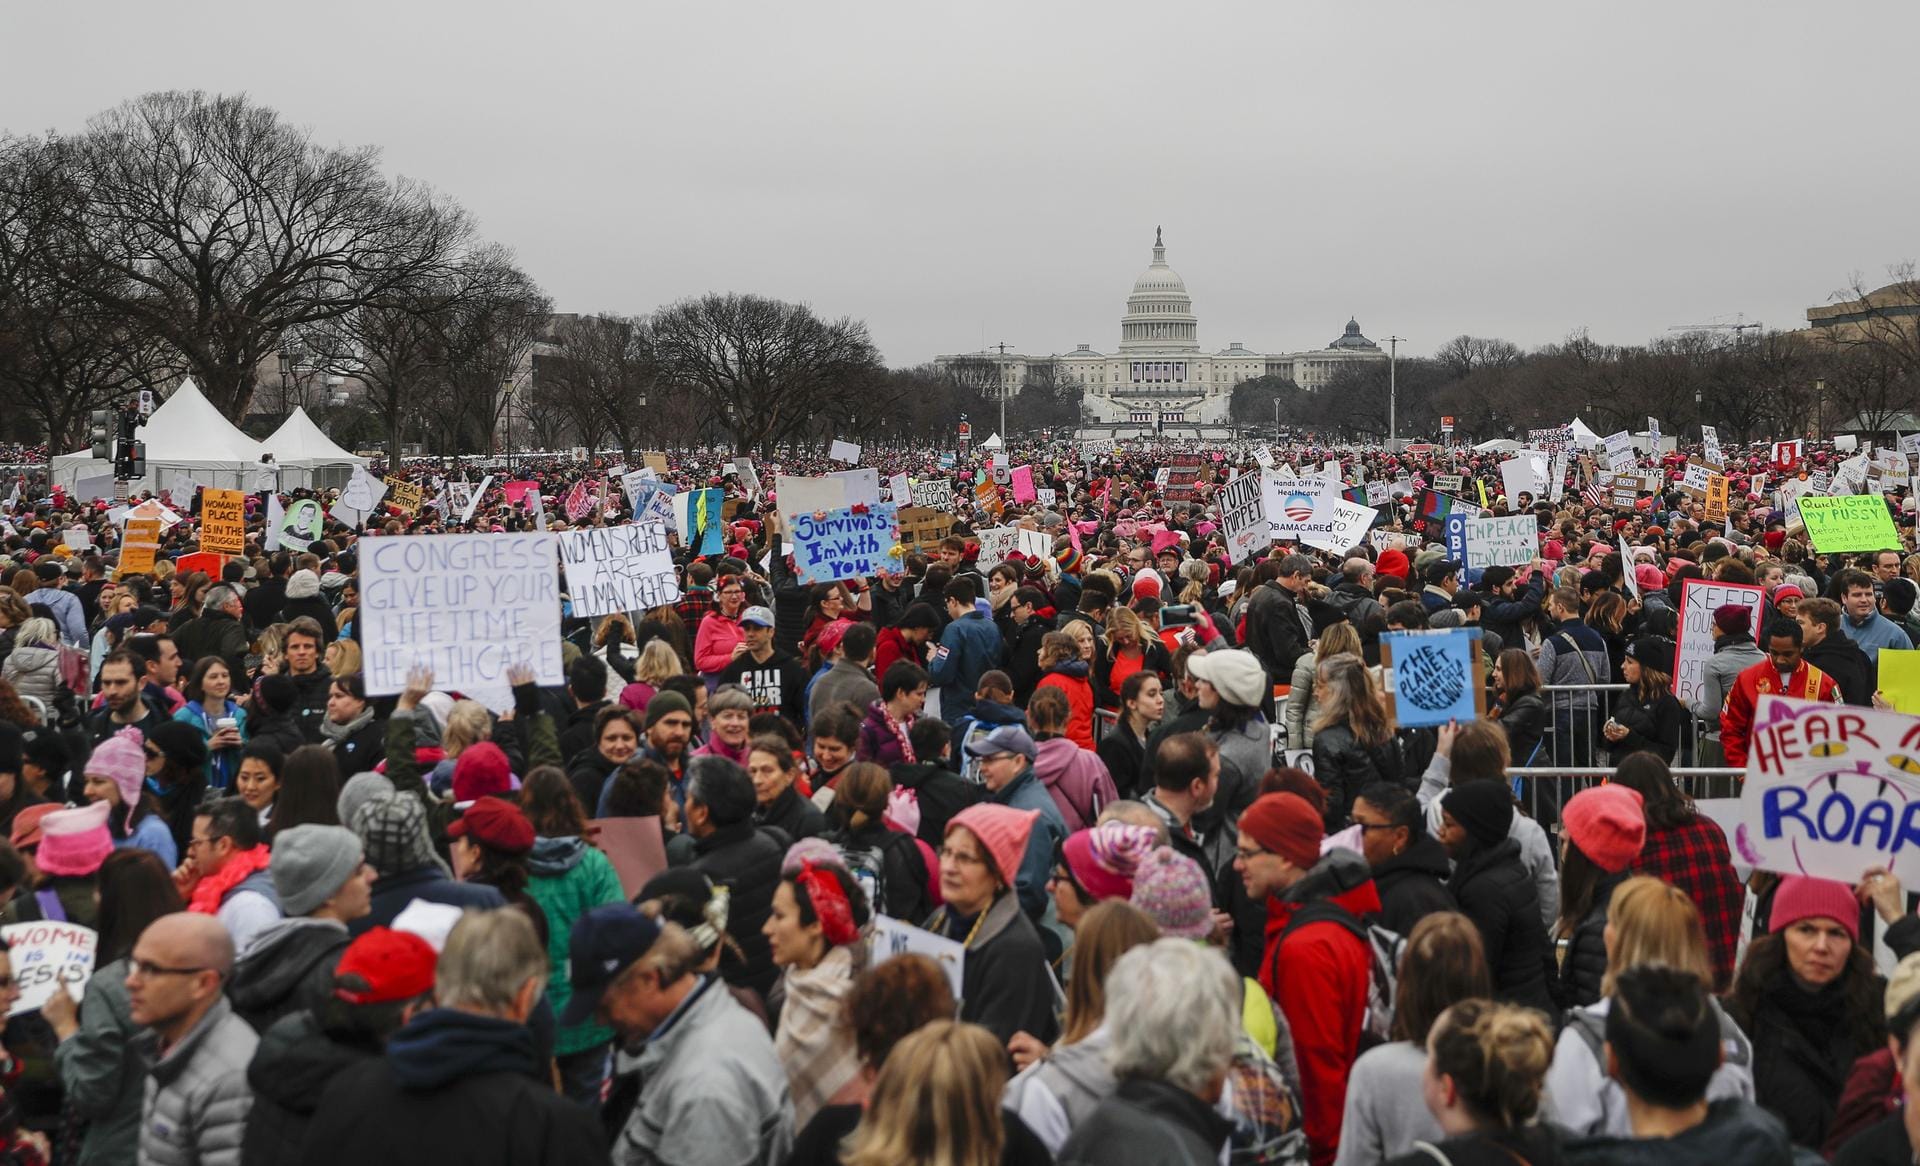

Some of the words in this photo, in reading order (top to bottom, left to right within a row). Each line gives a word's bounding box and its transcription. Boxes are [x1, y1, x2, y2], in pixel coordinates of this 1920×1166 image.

[1529, 433, 1575, 444] OPPRESSION
[911, 481, 951, 495] WELCOME
[1273, 479, 1296, 488] Hands
[1298, 479, 1312, 488] Off
[1314, 480, 1326, 489] My
[1617, 478, 1637, 487] LOVE
[1277, 488, 1321, 497] Healthcare!
[1614, 497, 1633, 506] HATE
[1801, 497, 1841, 509] Quick!
[1843, 495, 1882, 507] Grab
[204, 500, 243, 511] WOMAN'S
[650, 501, 676, 520] HILLAR
[207, 510, 239, 522] PLACE
[1223, 499, 1262, 536] PUPPET
[203, 524, 212, 533] IS
[213, 524, 223, 535] IN
[225, 525, 243, 537] THE
[1373, 531, 1393, 543] WE
[1466, 518, 1537, 541] IMPEACH
[834, 533, 880, 557] With
[373, 537, 550, 574] CONGRESS
[1467, 548, 1500, 567] TINY
[595, 556, 648, 580] ARE
[365, 575, 439, 611] GIVE
[444, 574, 479, 606] UP
[488, 571, 555, 604] YOUR
[571, 584, 627, 617] HUMAN
[1687, 585, 1760, 610] KEEP
[380, 607, 533, 645] LIFETIME
[1399, 645, 1433, 675] THE
[741, 668, 781, 689] CALI
[1400, 648, 1449, 698] PLANET
[1753, 714, 1881, 776] HEAR
[25, 949, 44, 963] IS
[66, 950, 90, 964] IN
